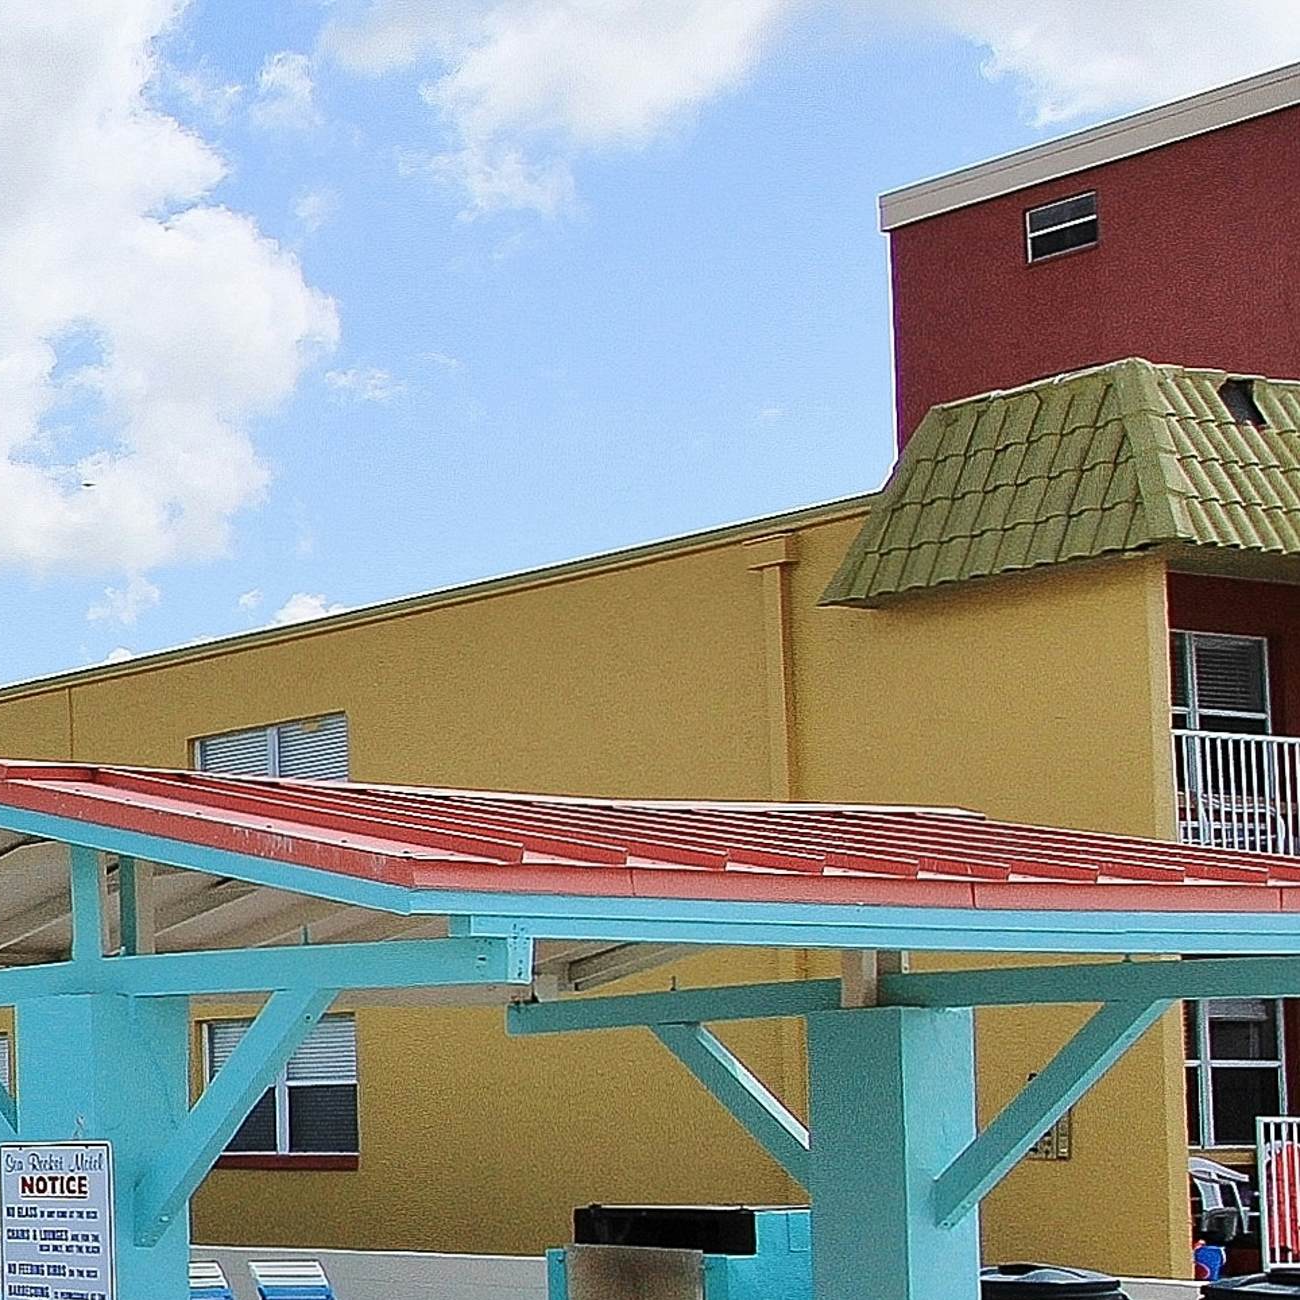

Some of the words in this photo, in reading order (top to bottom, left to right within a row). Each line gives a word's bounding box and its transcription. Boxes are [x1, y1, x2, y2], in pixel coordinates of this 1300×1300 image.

[20, 1175, 88, 1195] NOTICE
[17, 1206, 38, 1218] GLASS
[6, 1228, 30, 1240] CHAIRS
[39, 1229, 69, 1242] LOUNGES
[18, 1263, 45, 1276] FEEDING
[47, 1264, 67, 1277] BIRDS
